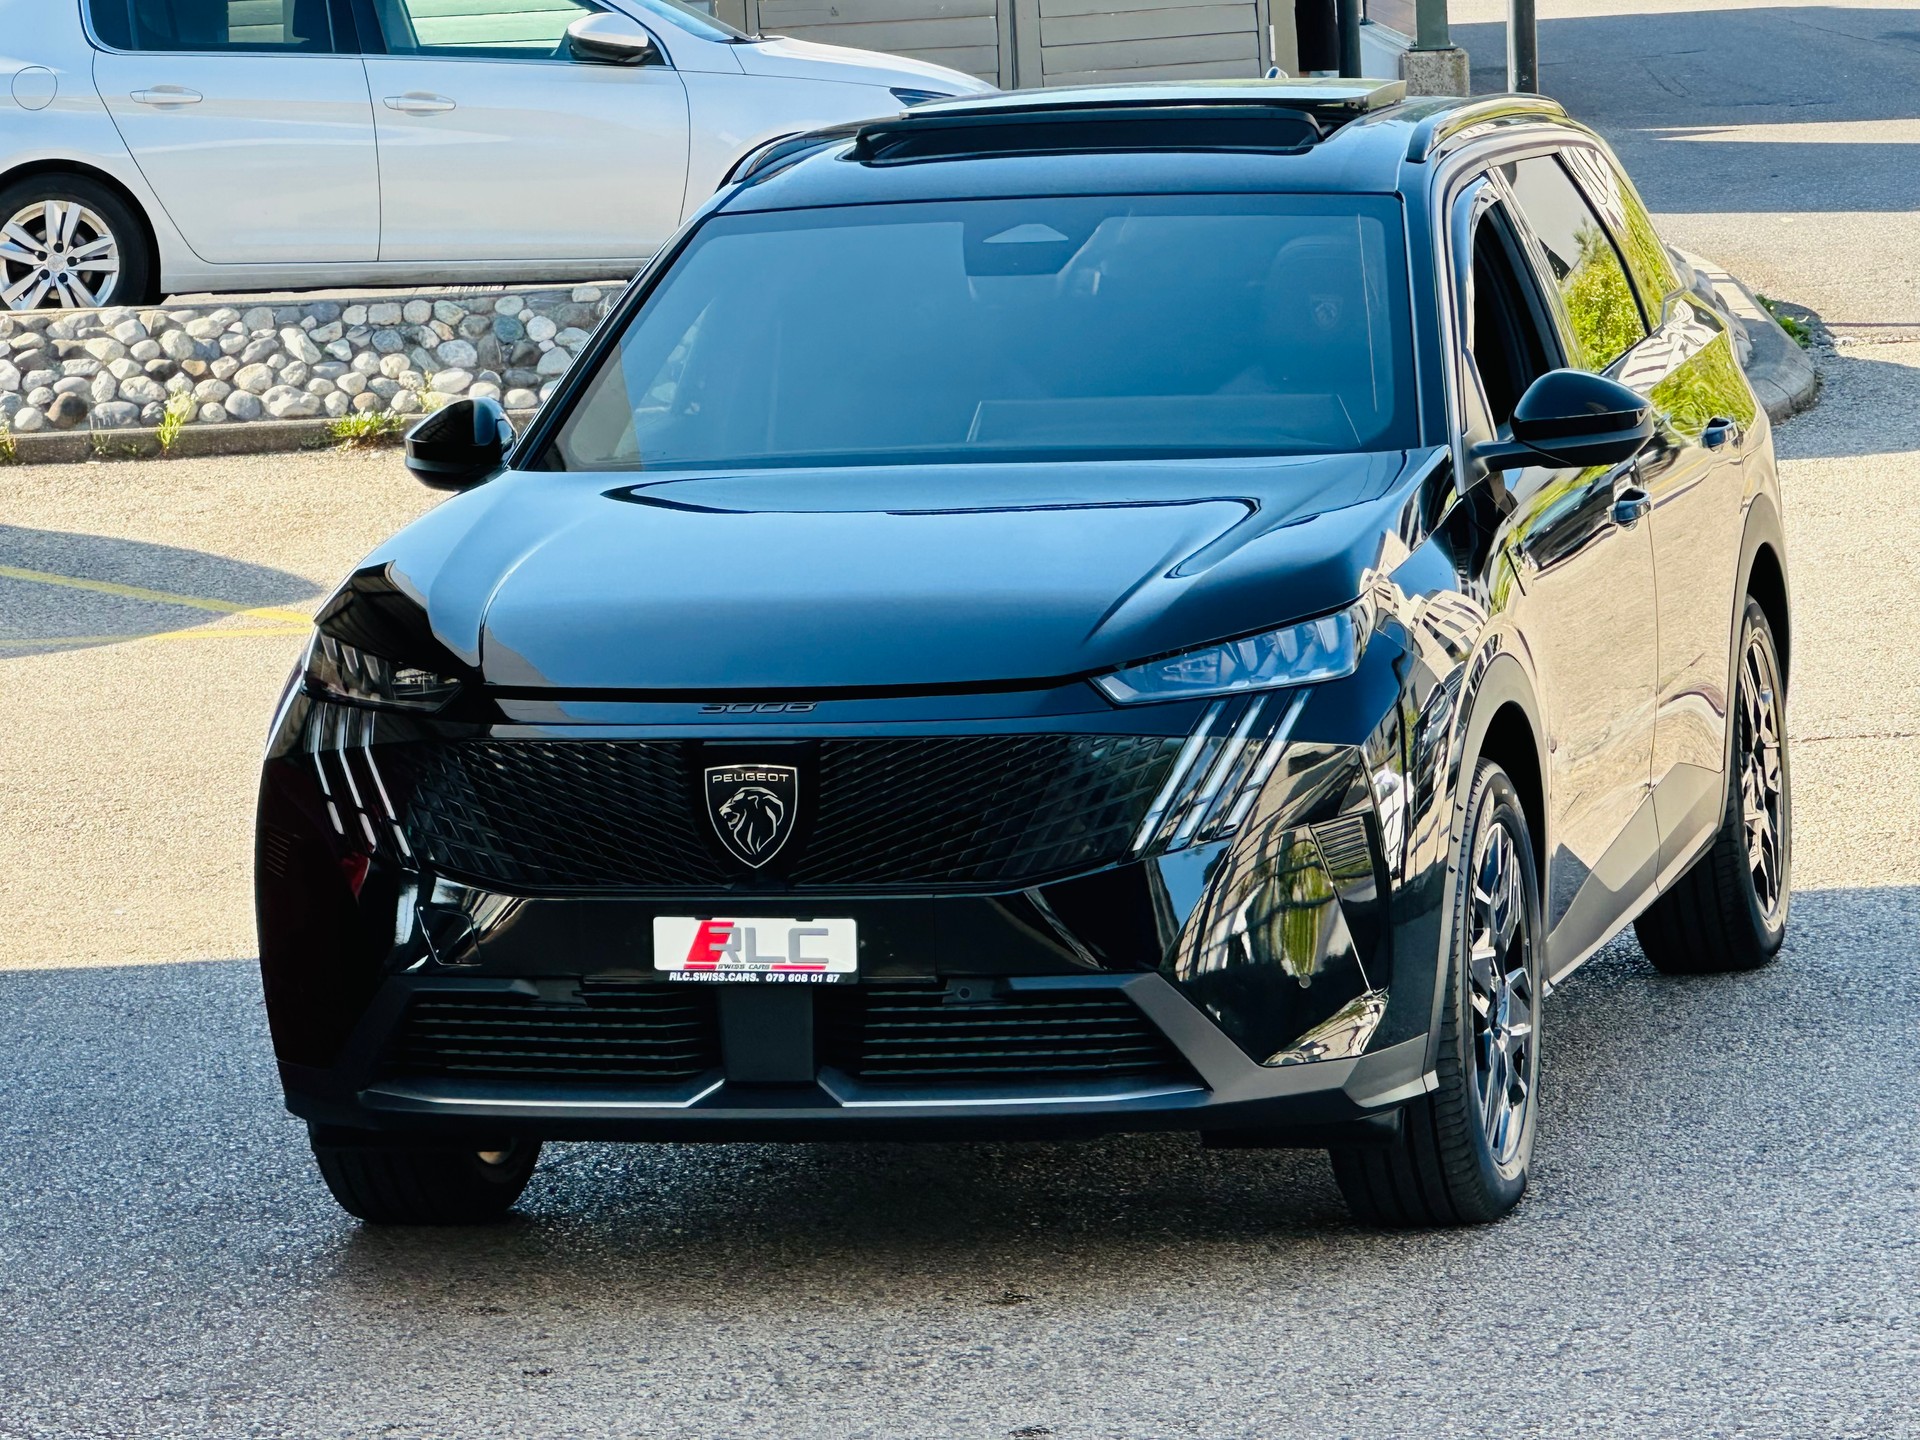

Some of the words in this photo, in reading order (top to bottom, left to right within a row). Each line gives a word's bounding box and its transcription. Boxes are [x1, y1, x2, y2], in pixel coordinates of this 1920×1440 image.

[712, 773, 789, 783] PEUGEOT
[669, 972, 760, 982] RLC.SWISS.CARS.
[765, 974, 785, 983] 079
[788, 974, 807, 983] 608
[810, 974, 823, 983] 01
[826, 974, 840, 983] 87
